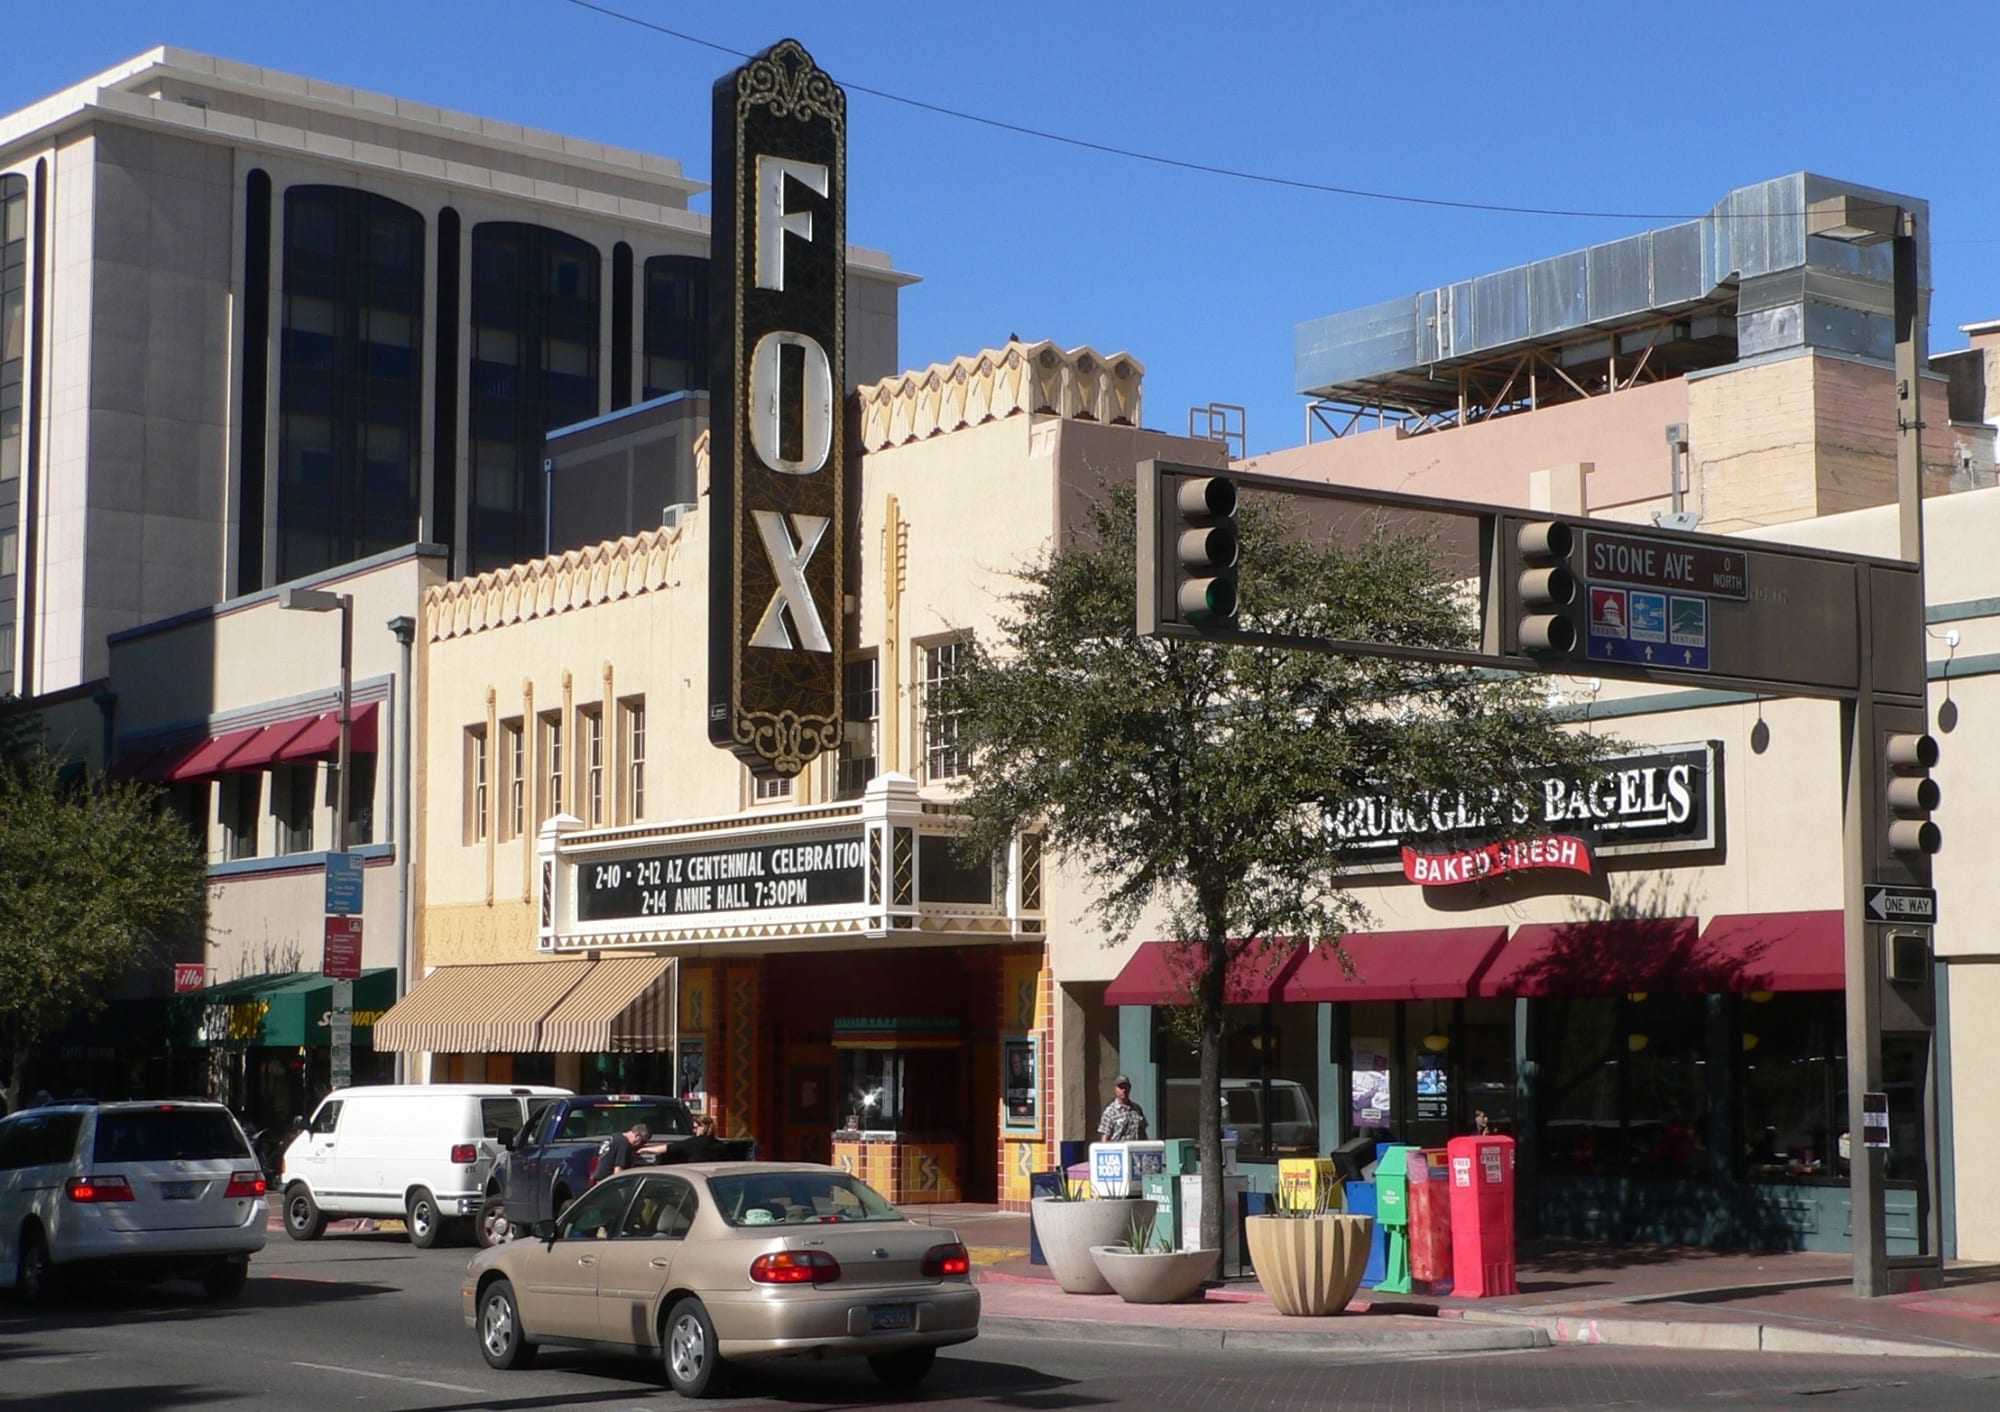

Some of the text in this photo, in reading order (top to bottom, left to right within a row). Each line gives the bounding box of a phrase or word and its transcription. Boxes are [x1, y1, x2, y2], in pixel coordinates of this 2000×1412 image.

[748, 154, 833, 653] FOX
[1594, 543, 1695, 582] STONE AVE
[1712, 573, 1742, 590] NORTH
[1541, 764, 1691, 824] BAGELS
[595, 864, 621, 889] 2-10
[636, 860, 662, 886] 2-12
[666, 858, 683, 884] AZ
[687, 850, 766, 882] CENTENNIAL
[1413, 851, 1491, 881] BAKED
[641, 878, 808, 915] 2-14 ANNIE HALL 7:30PM
[1885, 896, 1930, 913] ONE WAY
[180, 969, 203, 989] illy
[317, 1010, 385, 1027] SWAY
[1097, 1165, 1121, 1177] TODAY
[1105, 1154, 1121, 1166] USA
